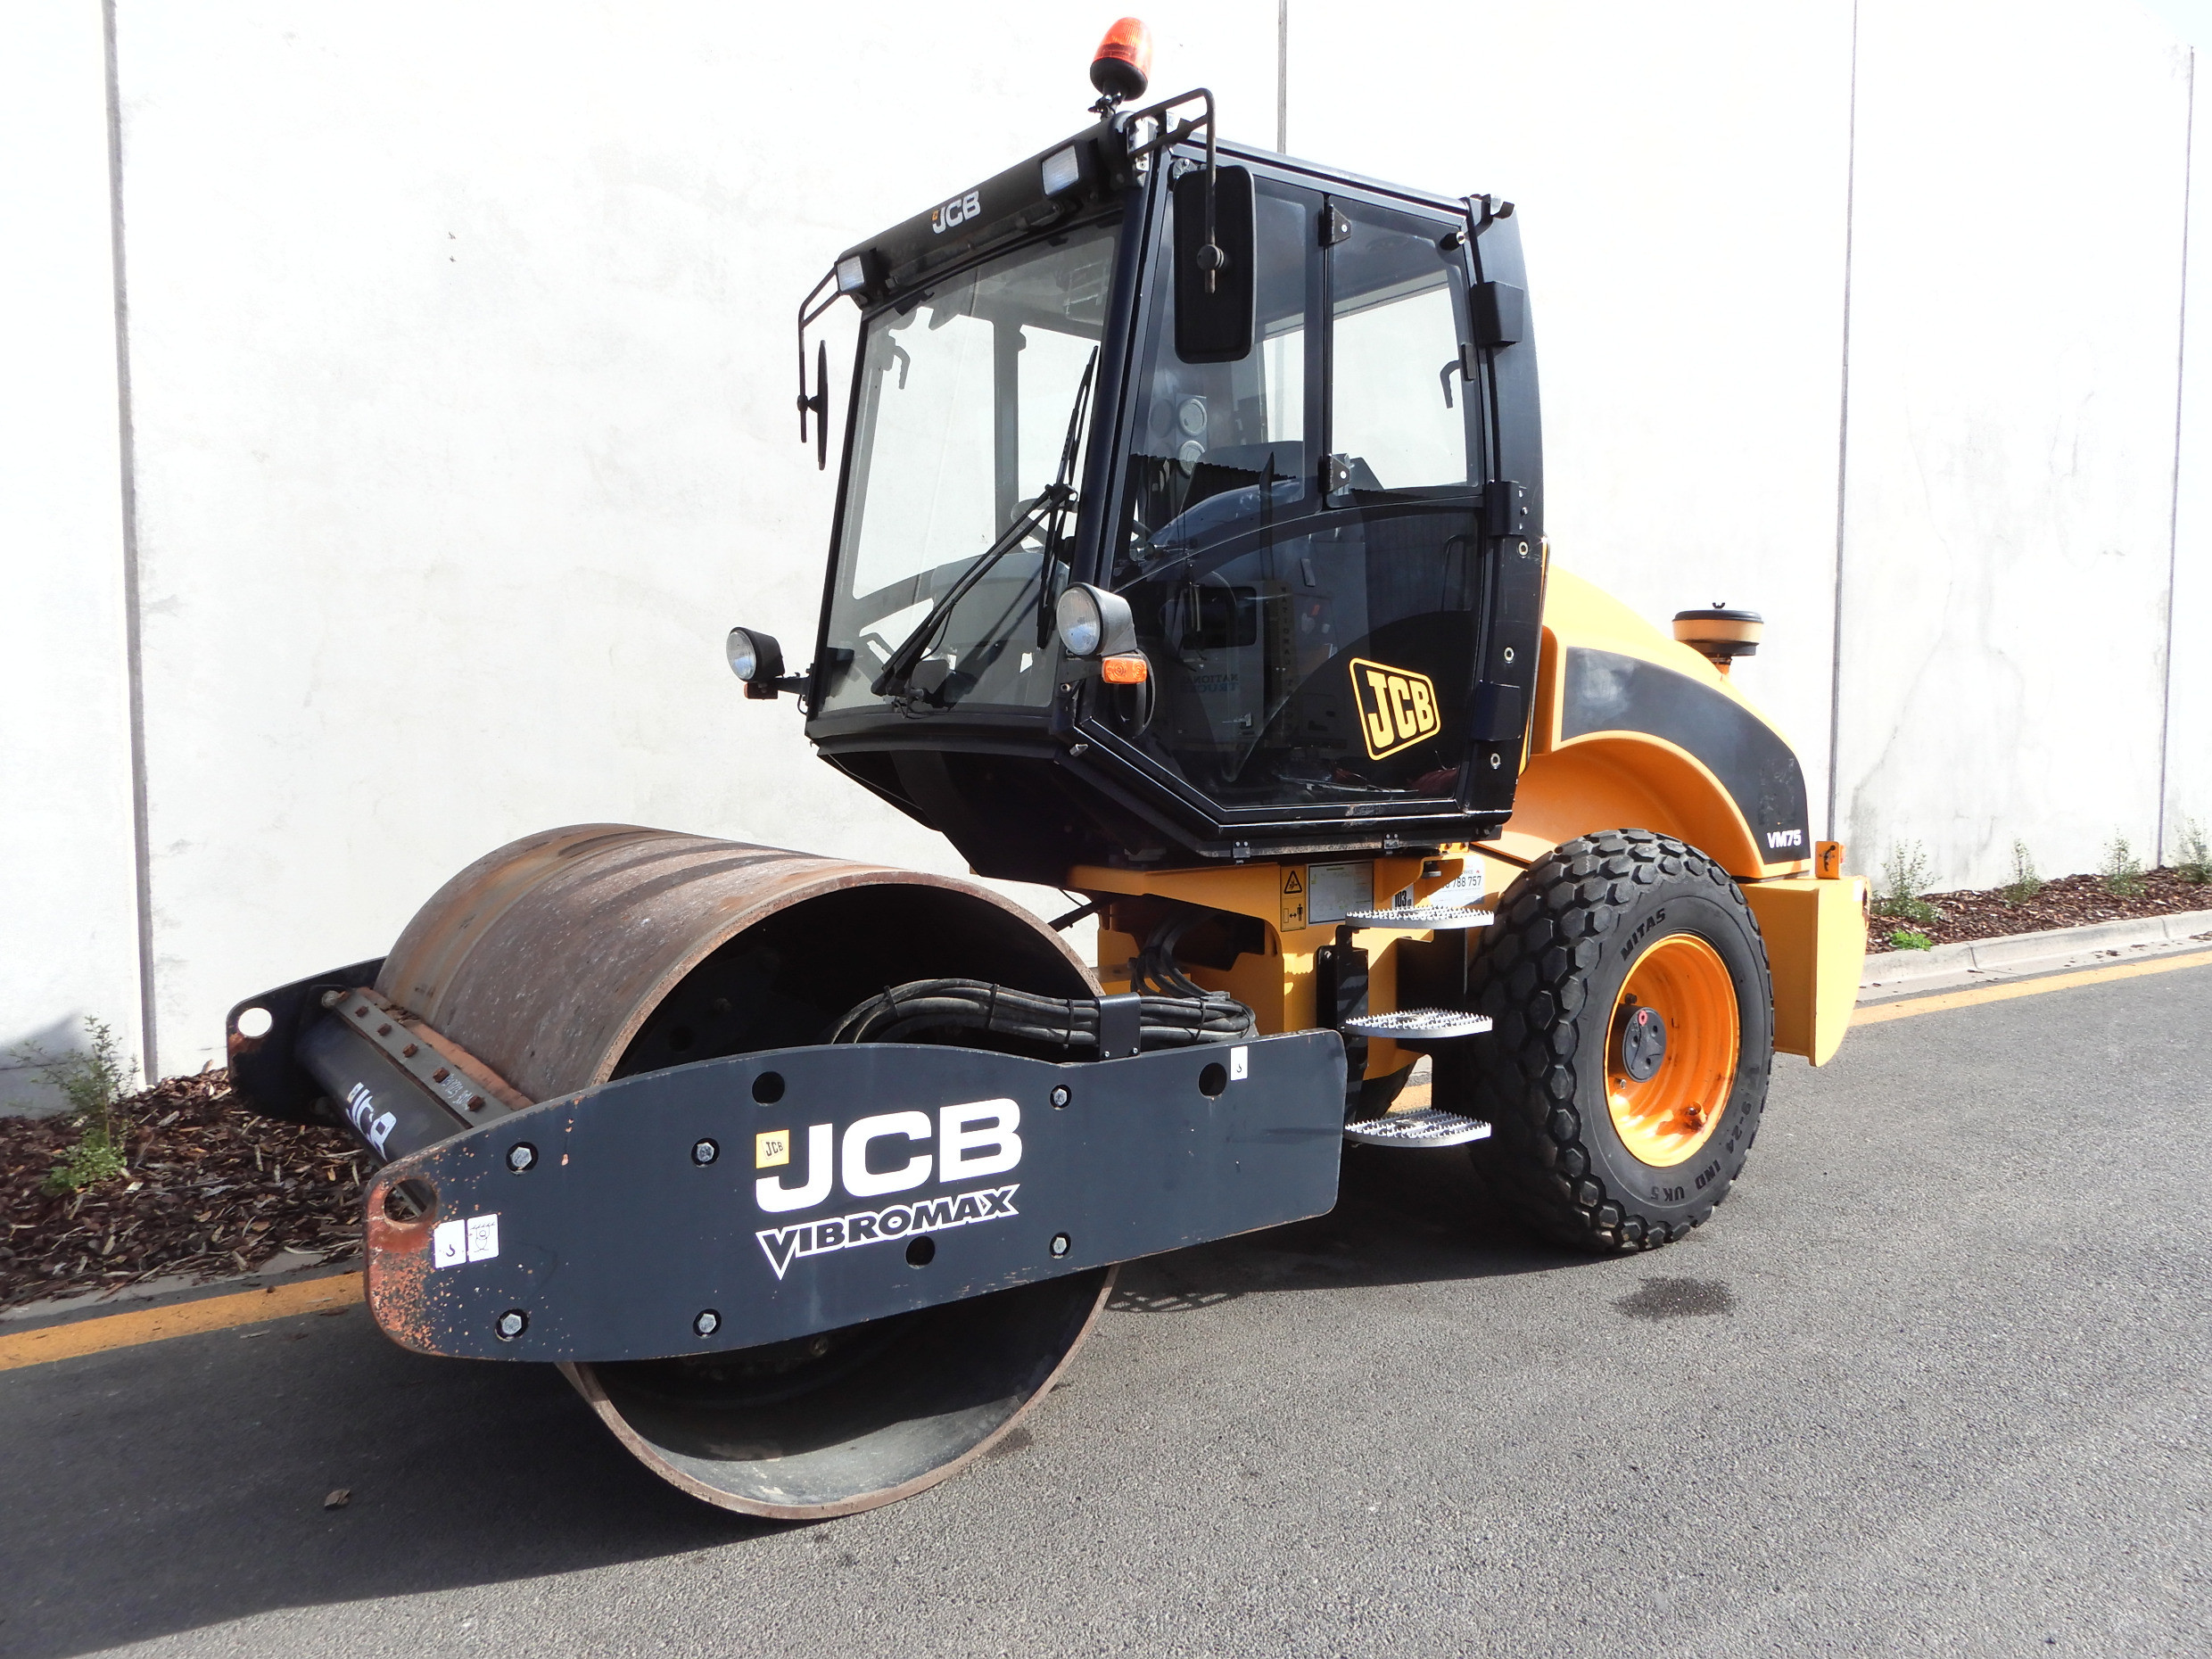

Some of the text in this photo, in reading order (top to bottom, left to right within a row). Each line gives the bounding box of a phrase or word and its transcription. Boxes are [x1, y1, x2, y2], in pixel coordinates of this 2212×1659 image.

[932, 191, 981, 234] JCB
[1366, 670, 1434, 748] JCB
[1767, 830, 1802, 848] VM75
[1468, 875, 1482, 887] 757
[1394, 890, 1407, 908] 103
[1621, 907, 1666, 962] MITAS
[755, 1098, 1023, 1213] JCB
[765, 1141, 784, 1157] JCB
[1663, 1185, 1685, 1201] UK
[755, 1184, 1020, 1281] VIBROMAX
